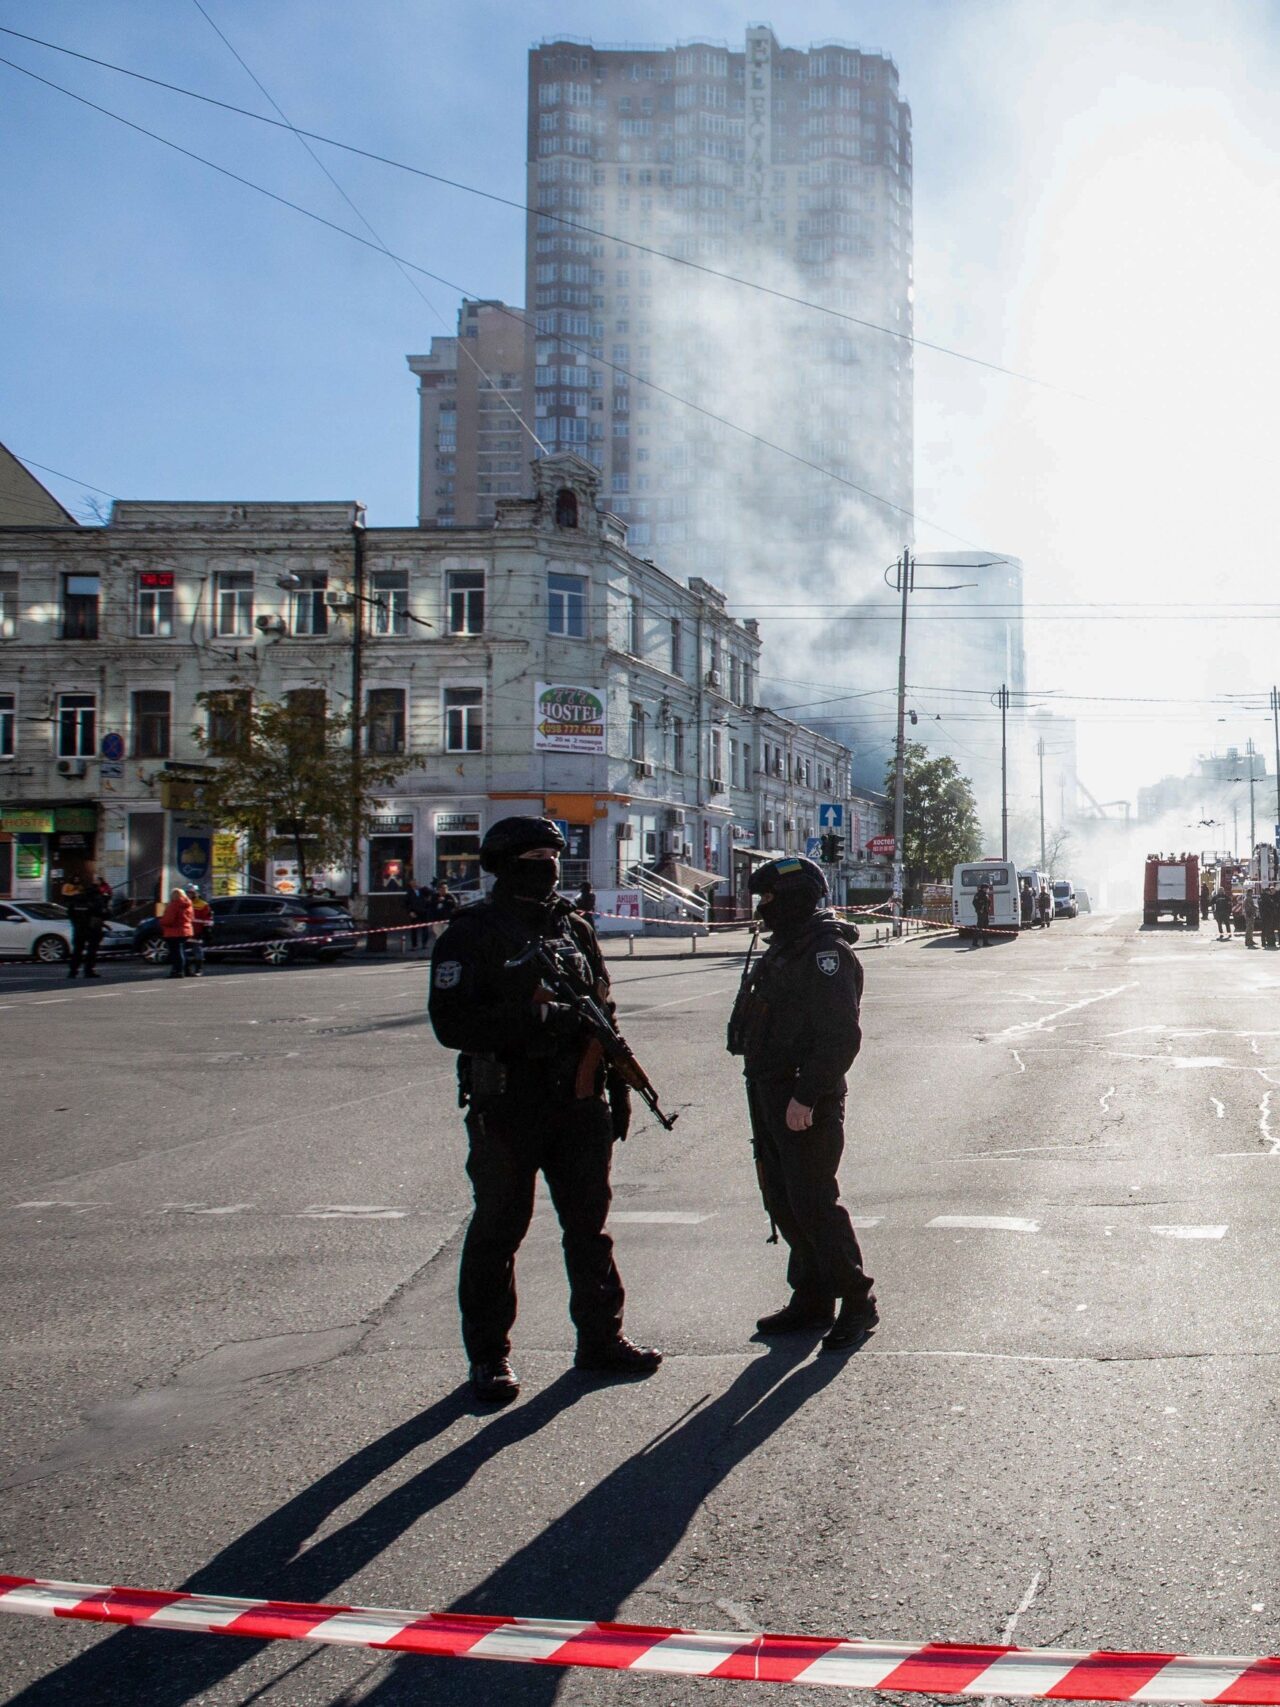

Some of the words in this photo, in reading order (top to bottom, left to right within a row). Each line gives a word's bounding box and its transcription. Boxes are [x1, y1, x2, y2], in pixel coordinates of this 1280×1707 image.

[554, 687, 588, 705] 777
[540, 701, 602, 721] HOSTEL
[563, 725, 579, 734] 777
[581, 725, 602, 735] 4477
